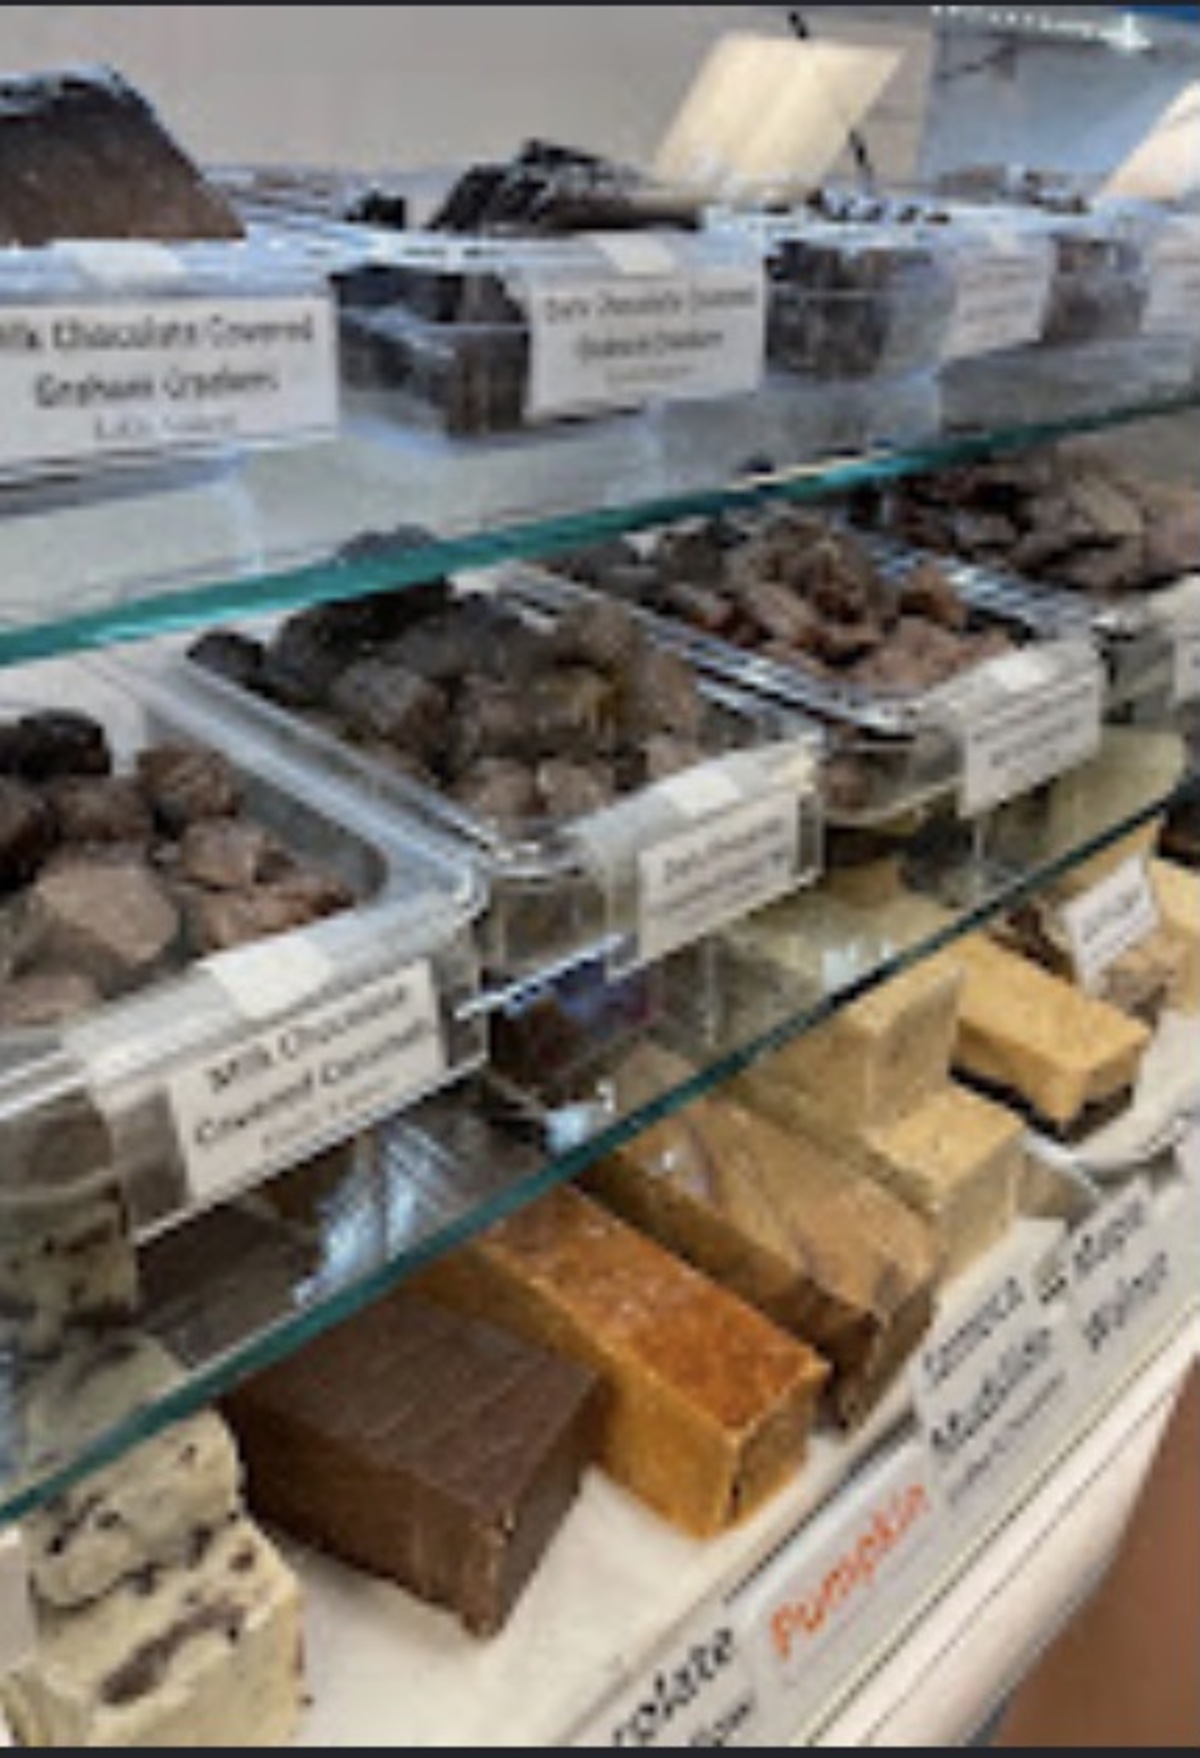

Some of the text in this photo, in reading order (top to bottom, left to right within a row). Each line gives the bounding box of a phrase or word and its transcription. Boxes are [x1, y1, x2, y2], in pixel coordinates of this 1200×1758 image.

[52, 314, 198, 350] Chocolate
[206, 311, 315, 349] Covered
[206, 1048, 274, 1093] Milk
[194, 1067, 317, 1146] Covered
[770, 1483, 933, 1664] Pumpkin
